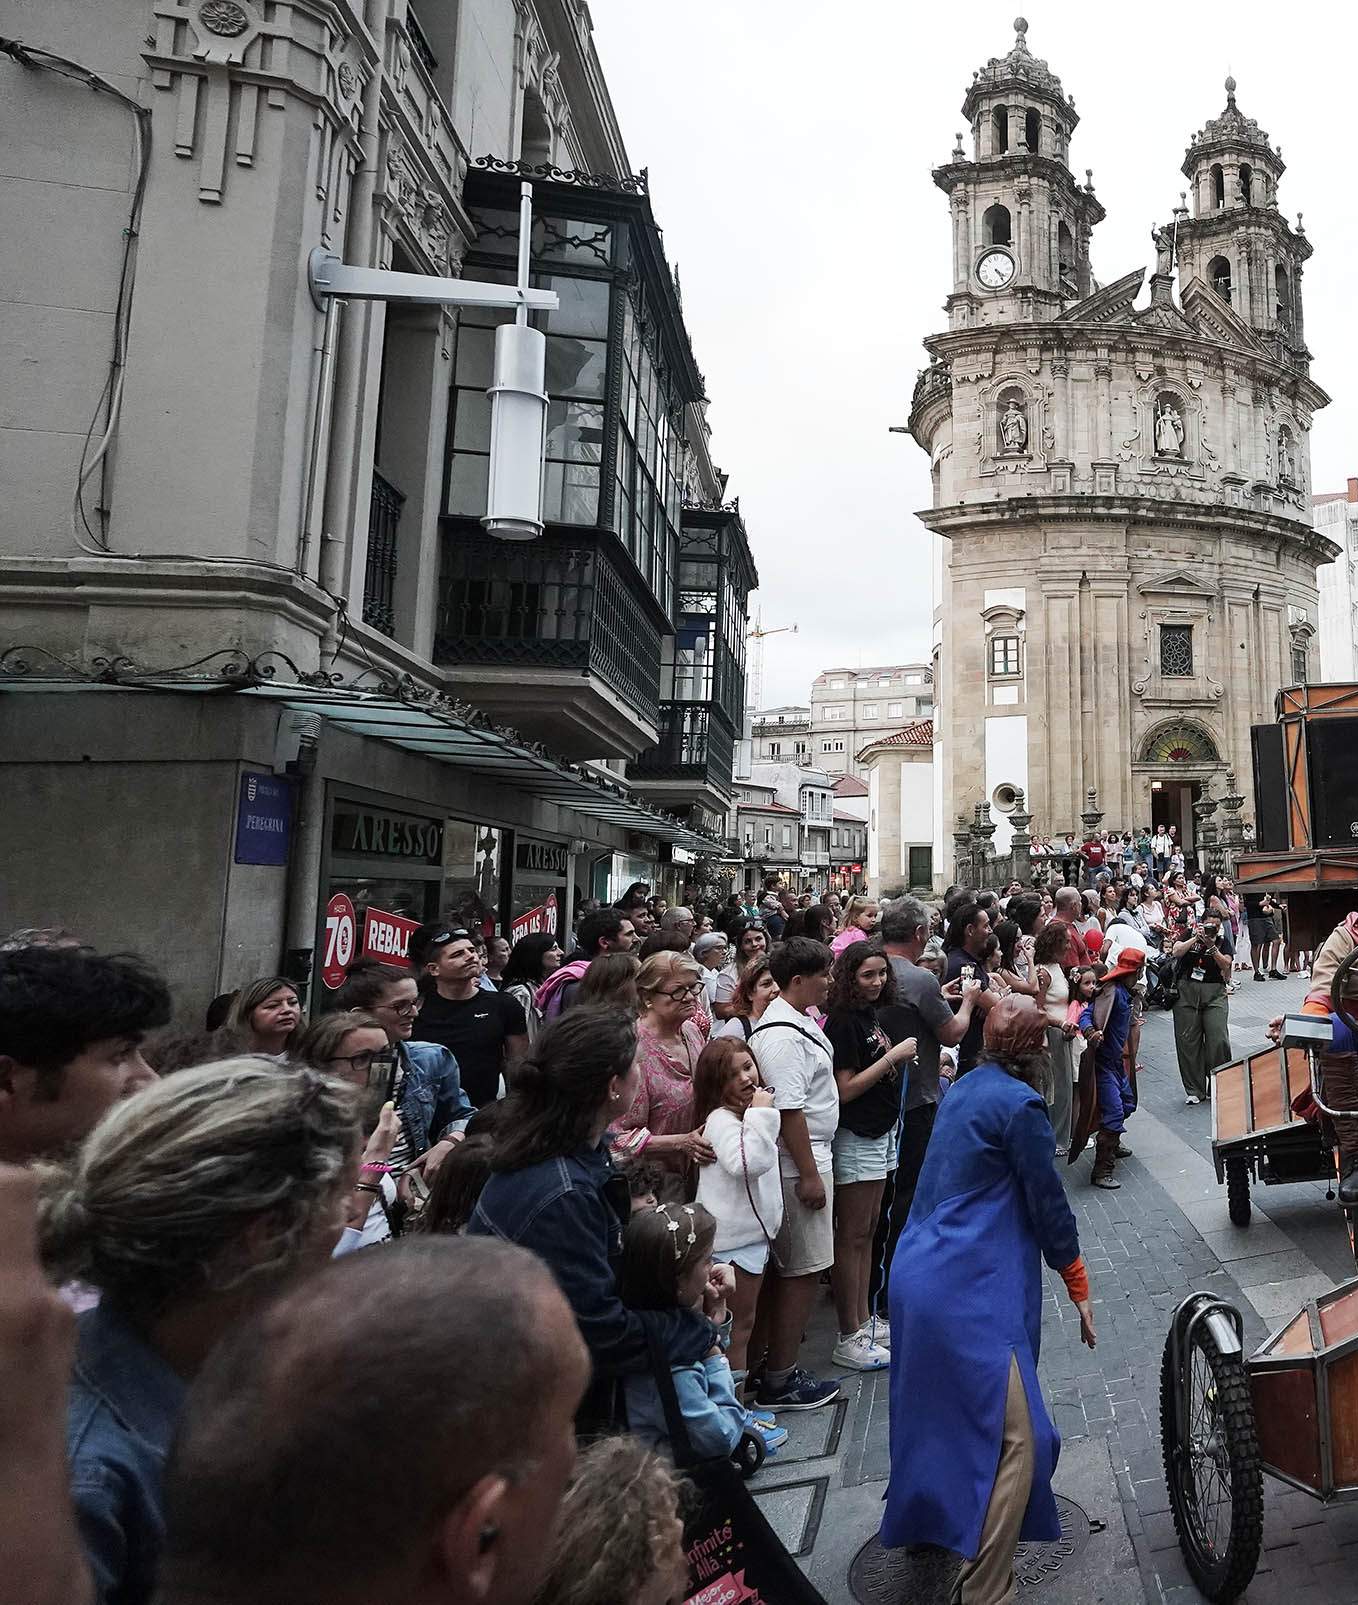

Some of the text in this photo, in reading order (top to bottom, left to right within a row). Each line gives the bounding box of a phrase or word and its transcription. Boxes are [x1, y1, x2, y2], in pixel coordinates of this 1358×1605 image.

[352, 813, 439, 859] ARESSO
[525, 842, 567, 872] ARESSO
[368, 919, 410, 958] REBAJ
[546, 906, 557, 936] 70
[324, 915, 353, 968] 70
[687, 1525, 733, 1564] nfinito
[696, 1556, 721, 1581] Allá
